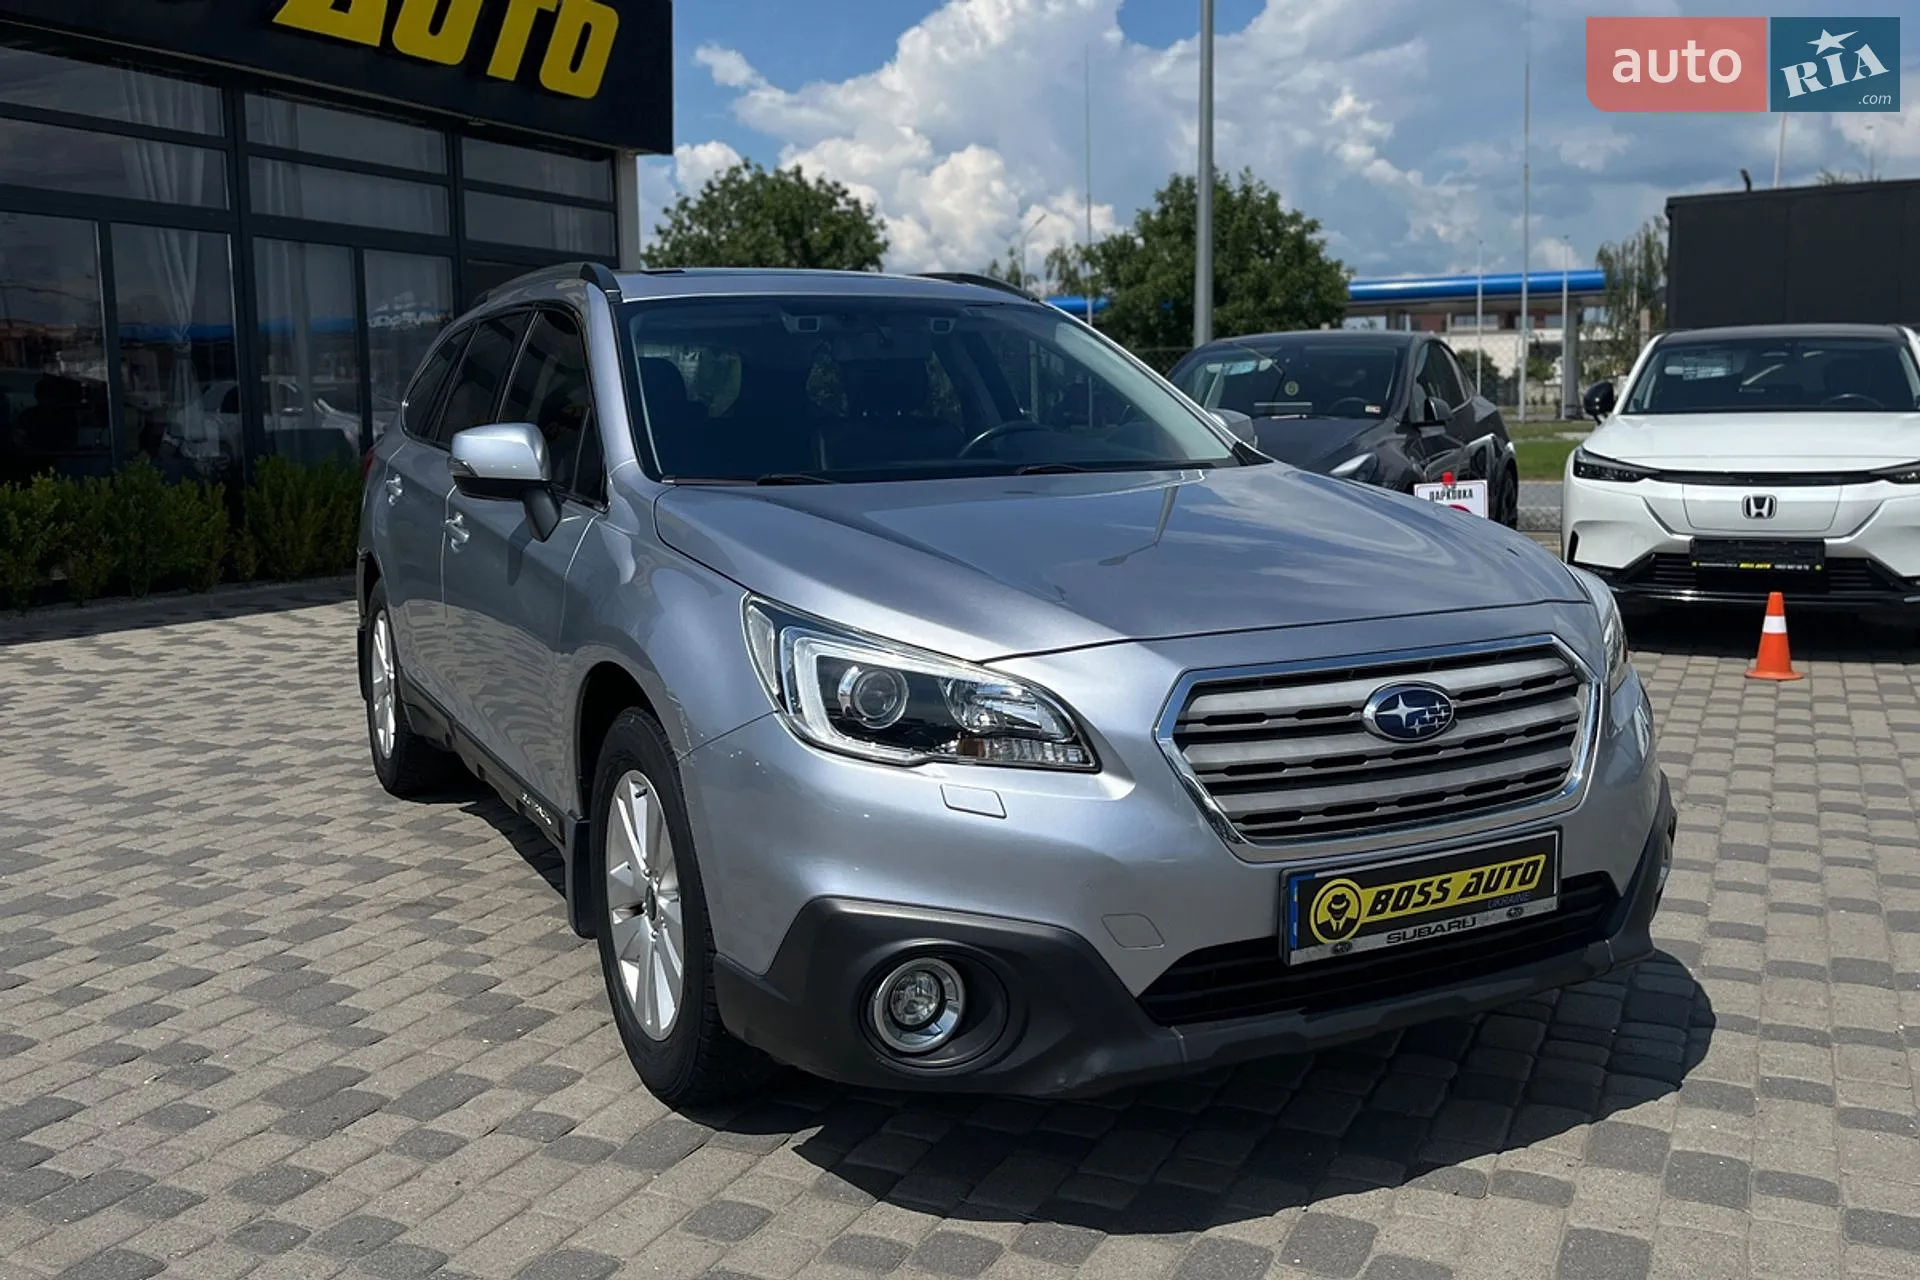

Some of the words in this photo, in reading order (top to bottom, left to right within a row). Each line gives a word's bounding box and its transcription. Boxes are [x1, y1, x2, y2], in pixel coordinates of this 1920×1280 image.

[1366, 877, 1453, 917] BOSS
[1459, 859, 1541, 899] AUTO
[1386, 917, 1477, 945] SUBARU
